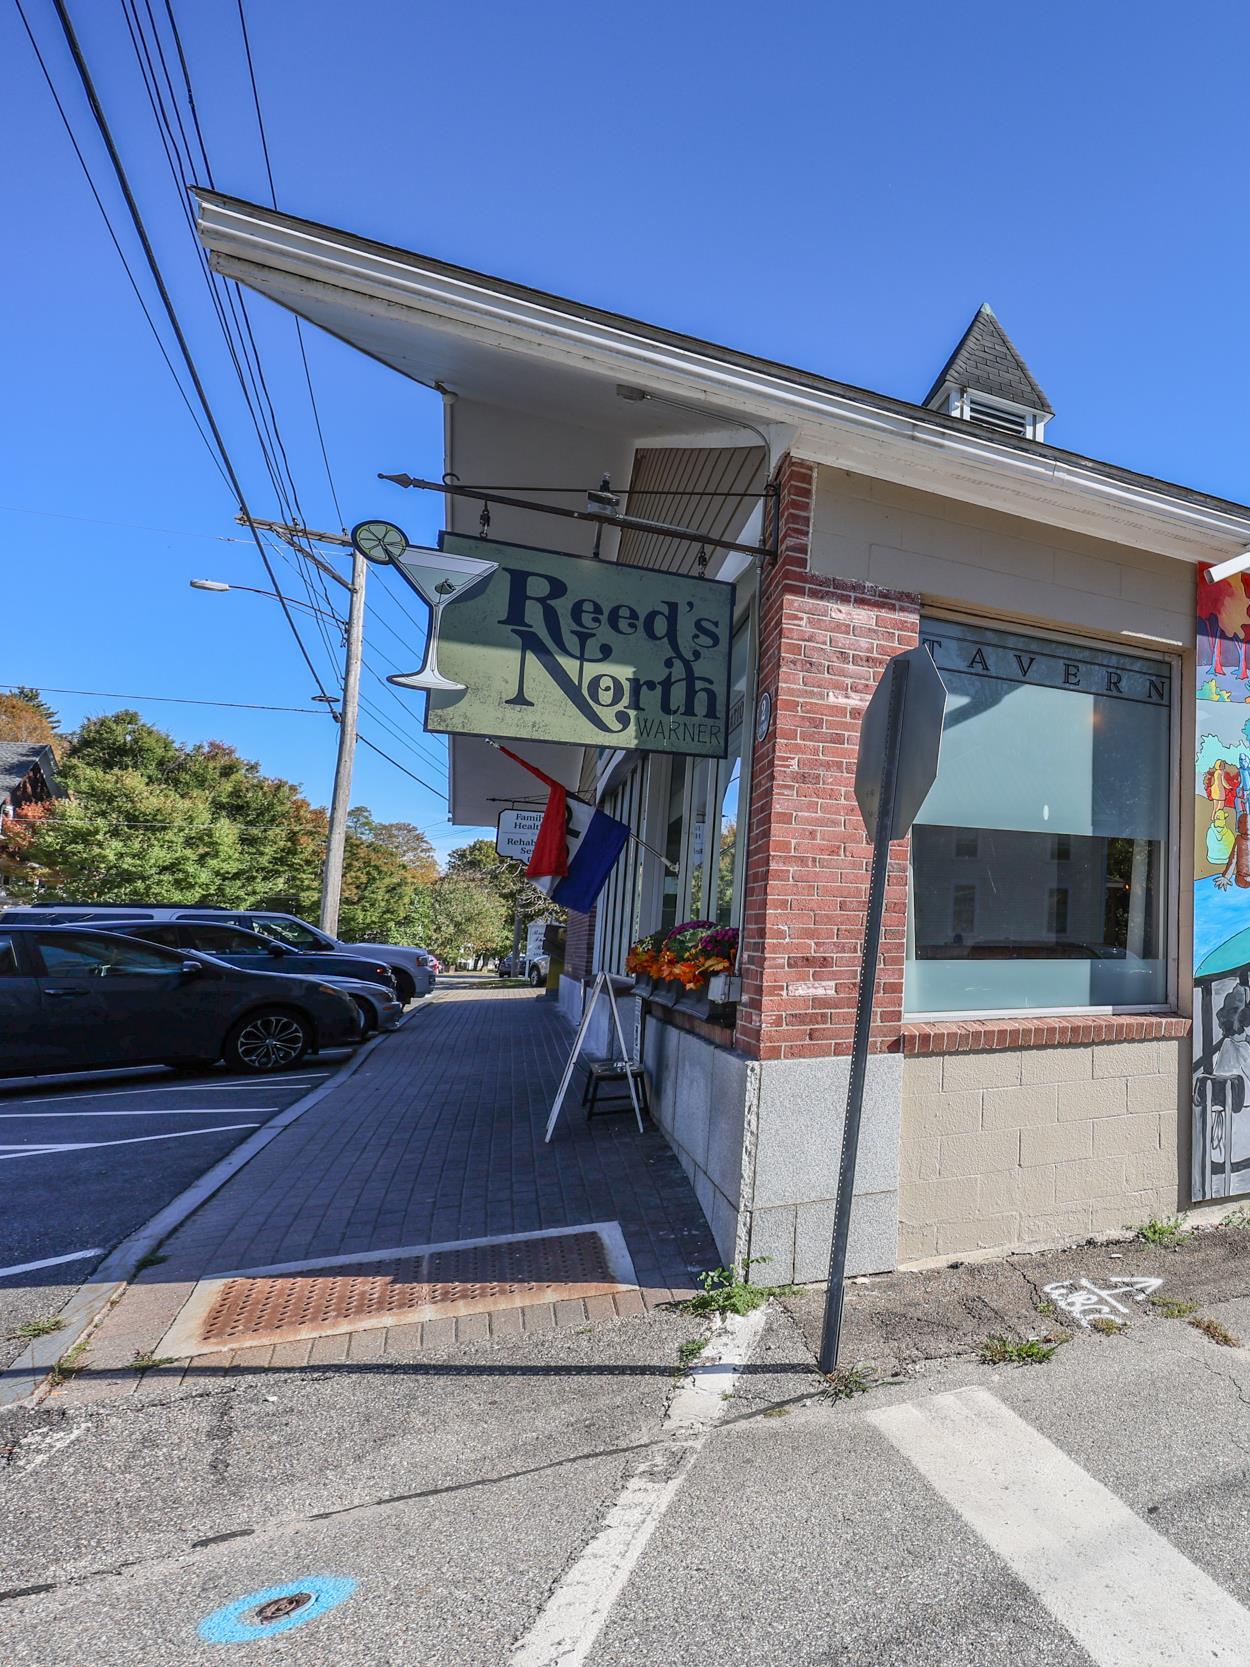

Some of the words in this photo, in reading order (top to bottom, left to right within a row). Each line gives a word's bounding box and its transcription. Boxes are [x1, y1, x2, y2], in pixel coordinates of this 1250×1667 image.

[497, 567, 720, 664] Reed's
[504, 628, 720, 734] North
[922, 638, 1166, 701] TAVERN
[635, 714, 721, 745] WARNER
[513, 821, 540, 830] Healt
[516, 813, 545, 822] Famil
[507, 837, 537, 847] Rehab
